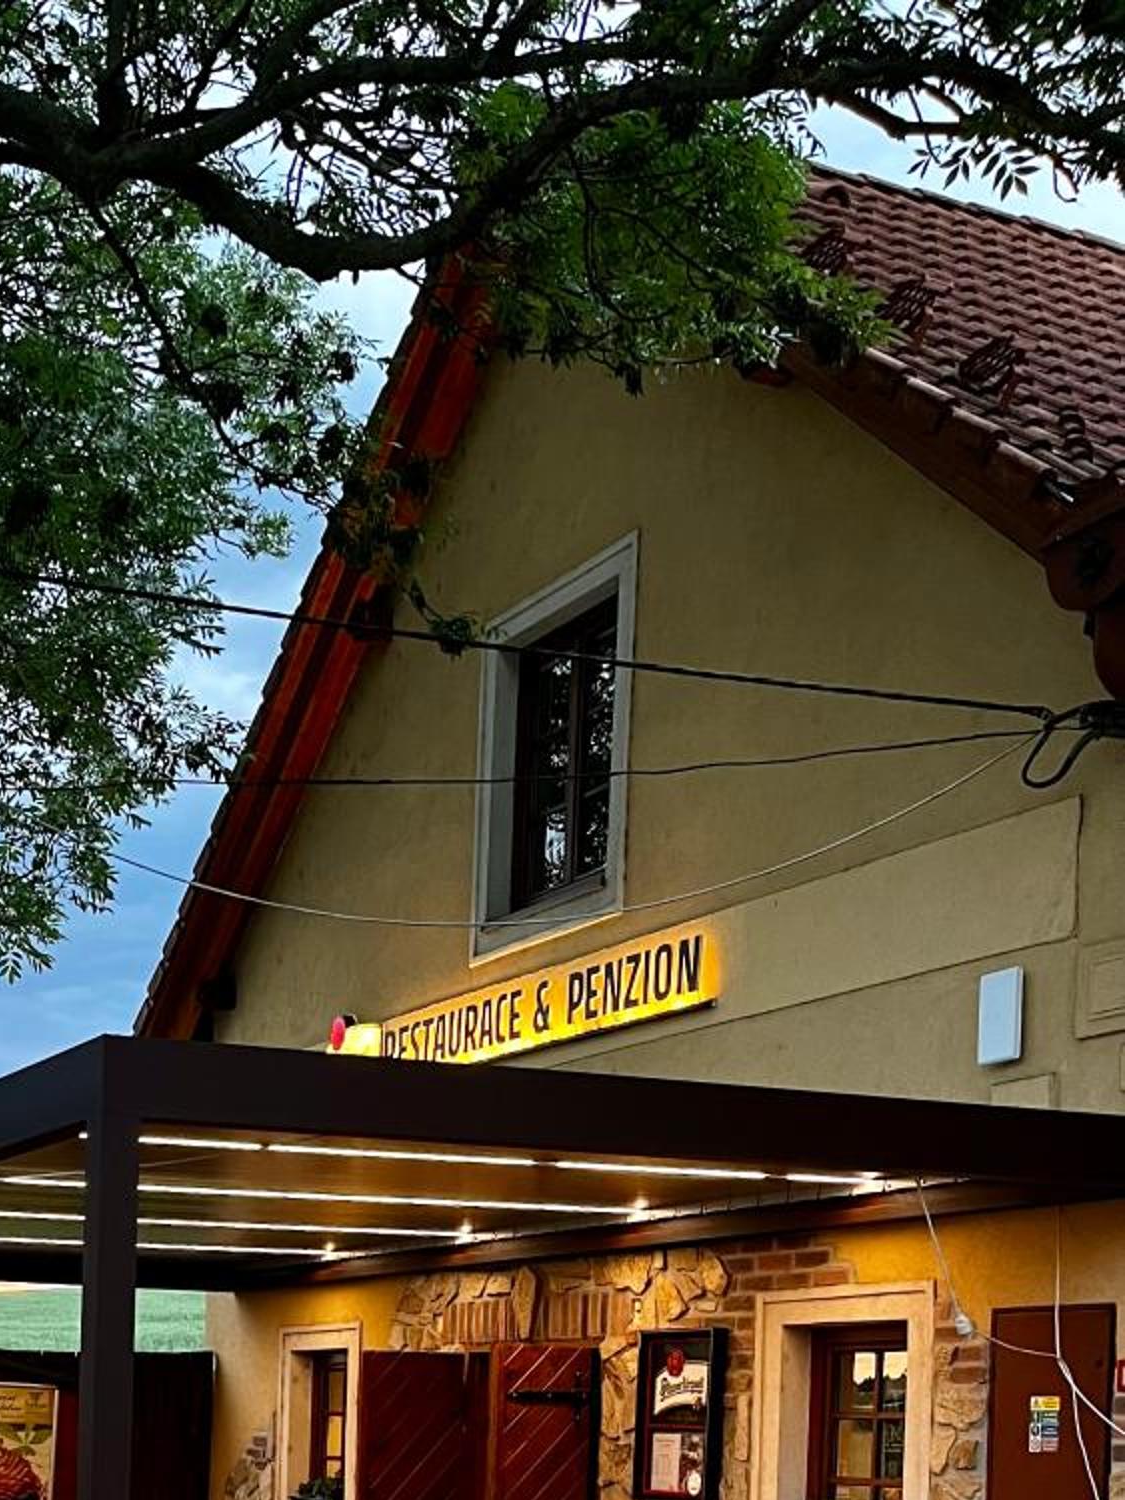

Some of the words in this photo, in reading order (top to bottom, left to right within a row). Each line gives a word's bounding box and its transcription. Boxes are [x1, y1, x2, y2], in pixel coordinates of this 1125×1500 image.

[384, 989, 523, 1061] RESTAURACE
[533, 980, 551, 1033] &
[567, 934, 704, 1025] PENZION
